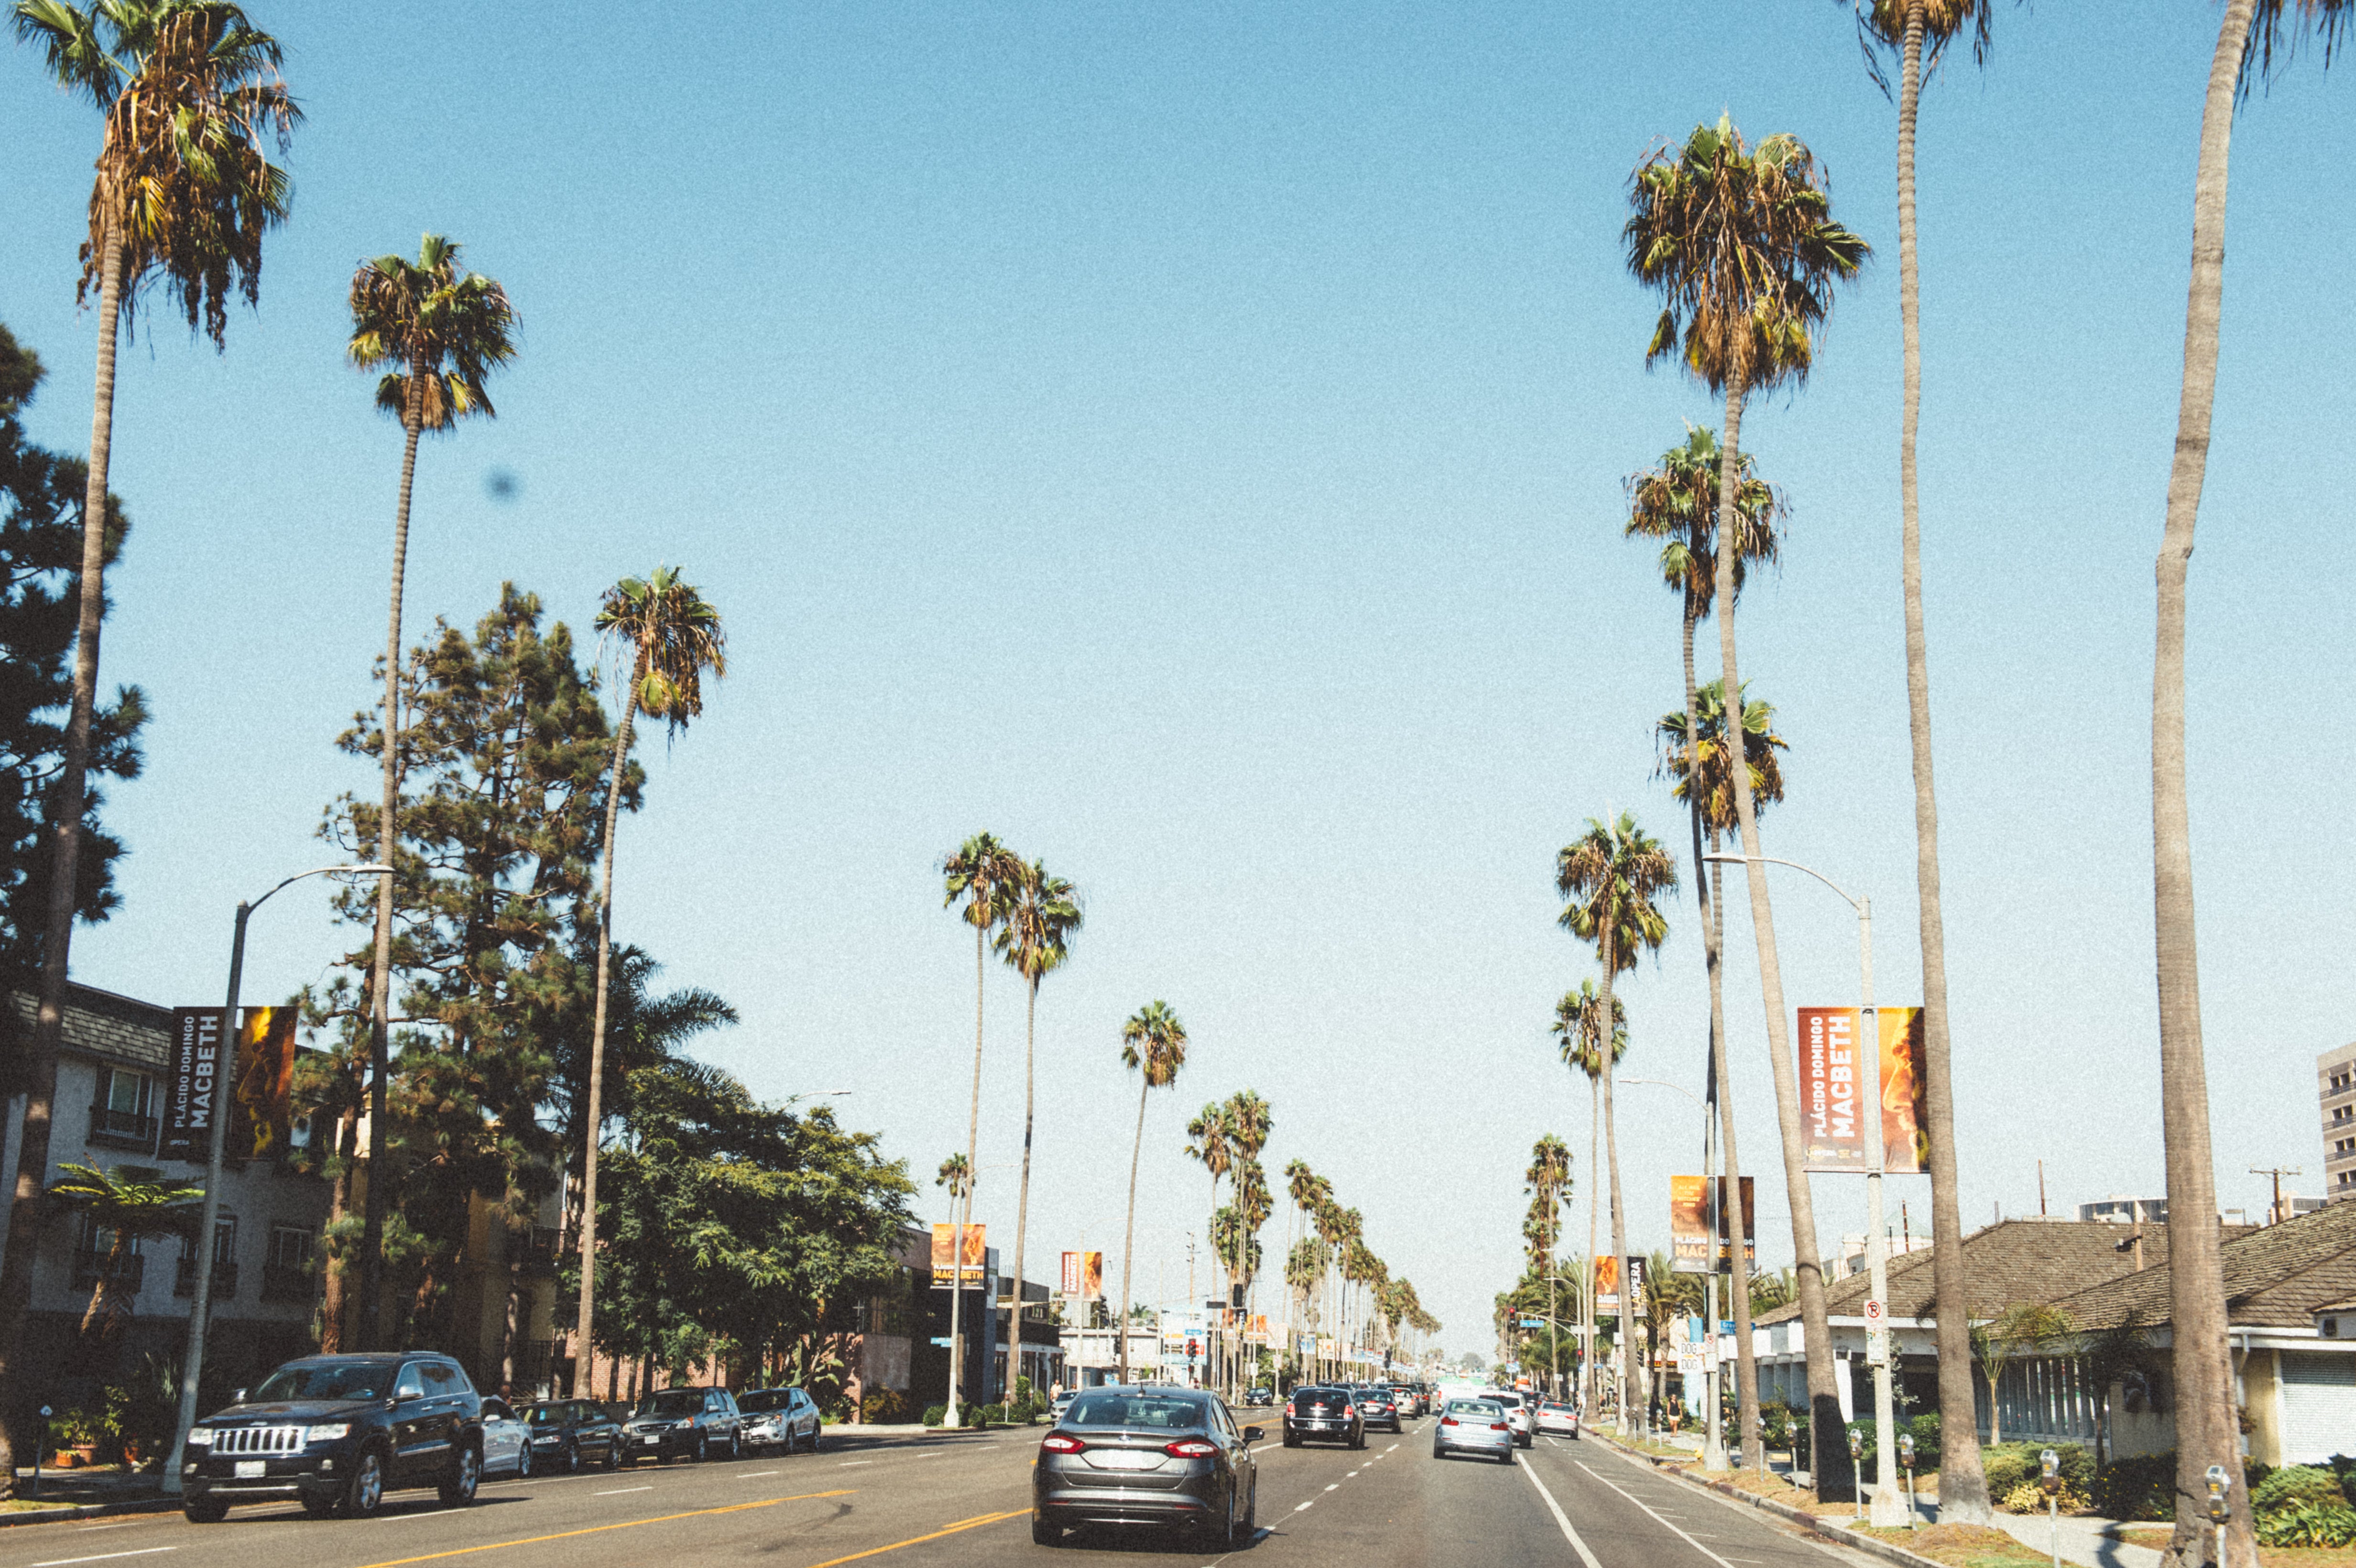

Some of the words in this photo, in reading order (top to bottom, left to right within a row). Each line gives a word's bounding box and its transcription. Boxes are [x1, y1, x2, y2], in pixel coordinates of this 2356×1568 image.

[181, 1016, 195, 1072] DOMINGO
[1811, 1016, 1824, 1078] DOMINGO
[190, 1016, 218, 1127] MACBETH
[1829, 1016, 1855, 1137] MACBETH
[174, 1076, 189, 1127] PLÁCIDO
[1810, 1080, 1827, 1137] PLÁCIDO
[933, 1270, 954, 1279] MAC
[960, 1270, 983, 1279] BETH
[1675, 1245, 1707, 1257] MAC
[1719, 1246, 1754, 1259] BEH
[1681, 1343, 1697, 1354] DOG
[1682, 1359, 1697, 1370] DOG
